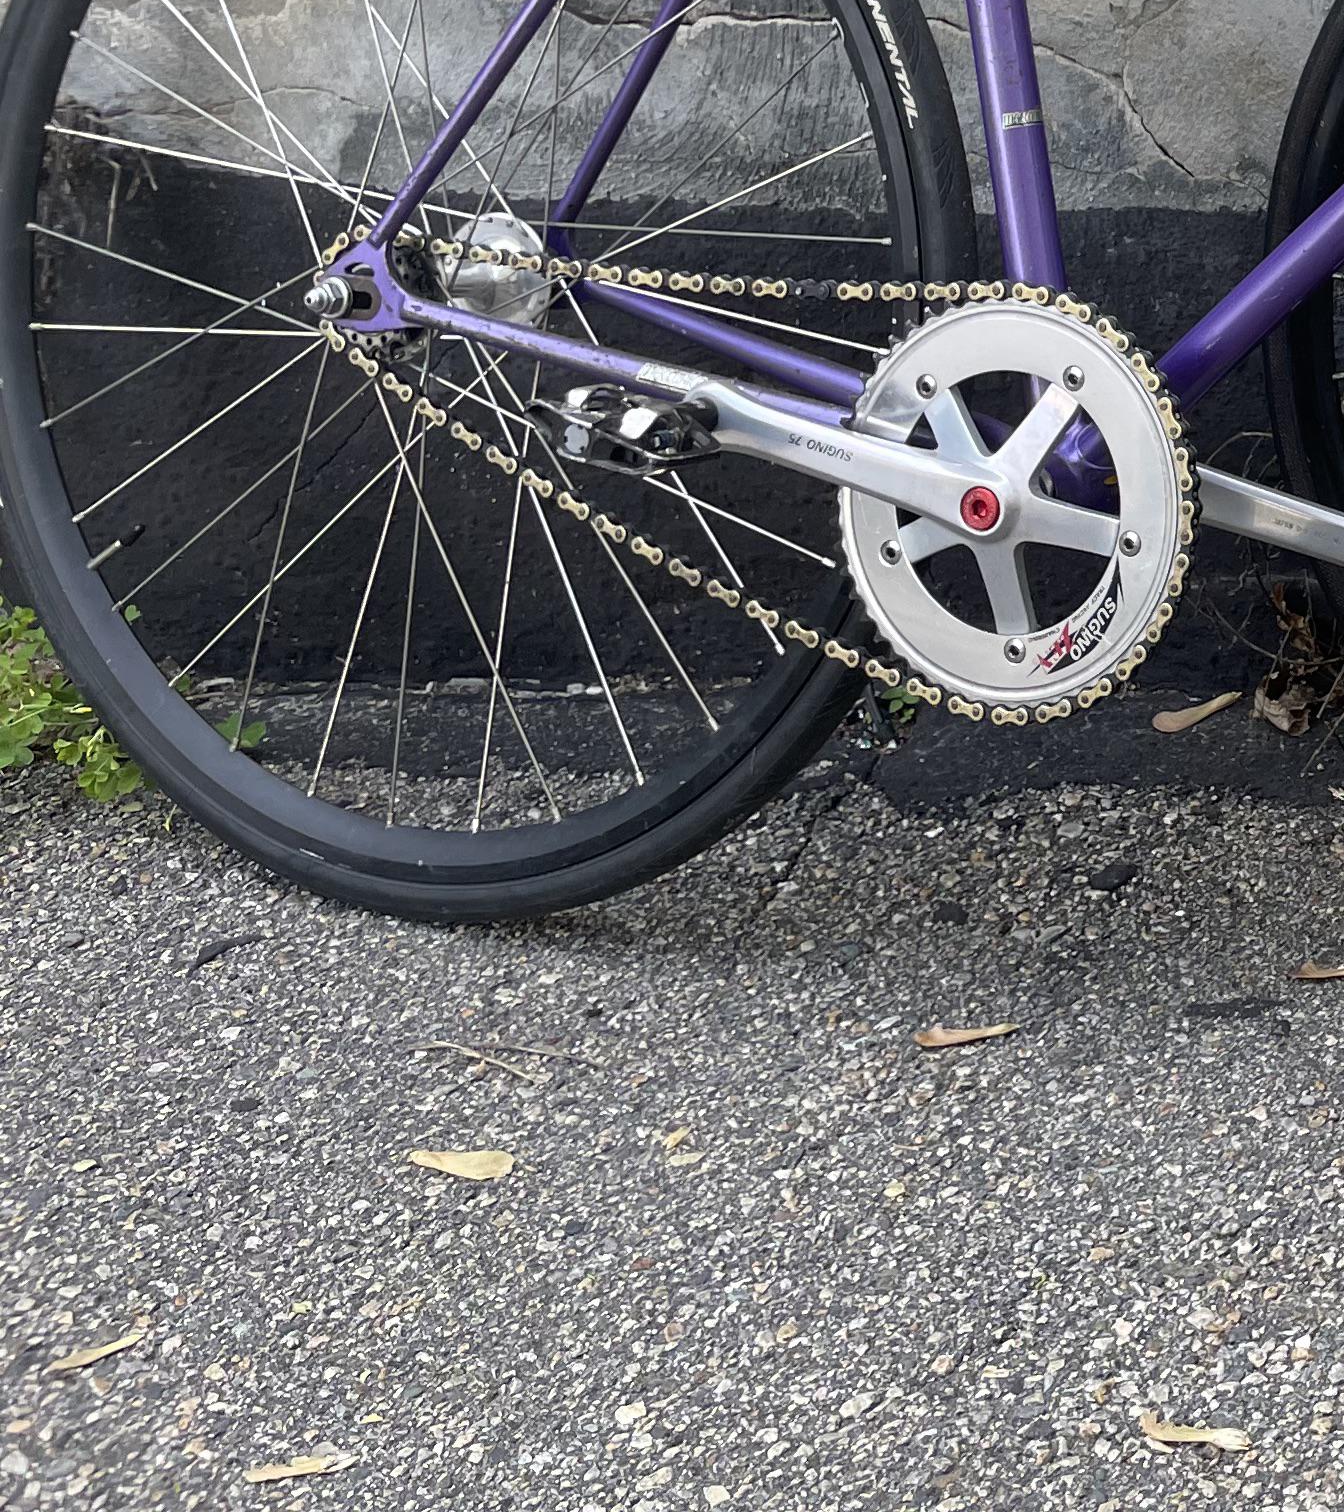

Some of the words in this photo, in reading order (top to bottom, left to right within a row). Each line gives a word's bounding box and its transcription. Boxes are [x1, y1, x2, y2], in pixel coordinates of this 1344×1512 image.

[788, 433, 803, 447] 75
[806, 438, 854, 463] SUGINO
[1069, 596, 1118, 662] SUGINO
